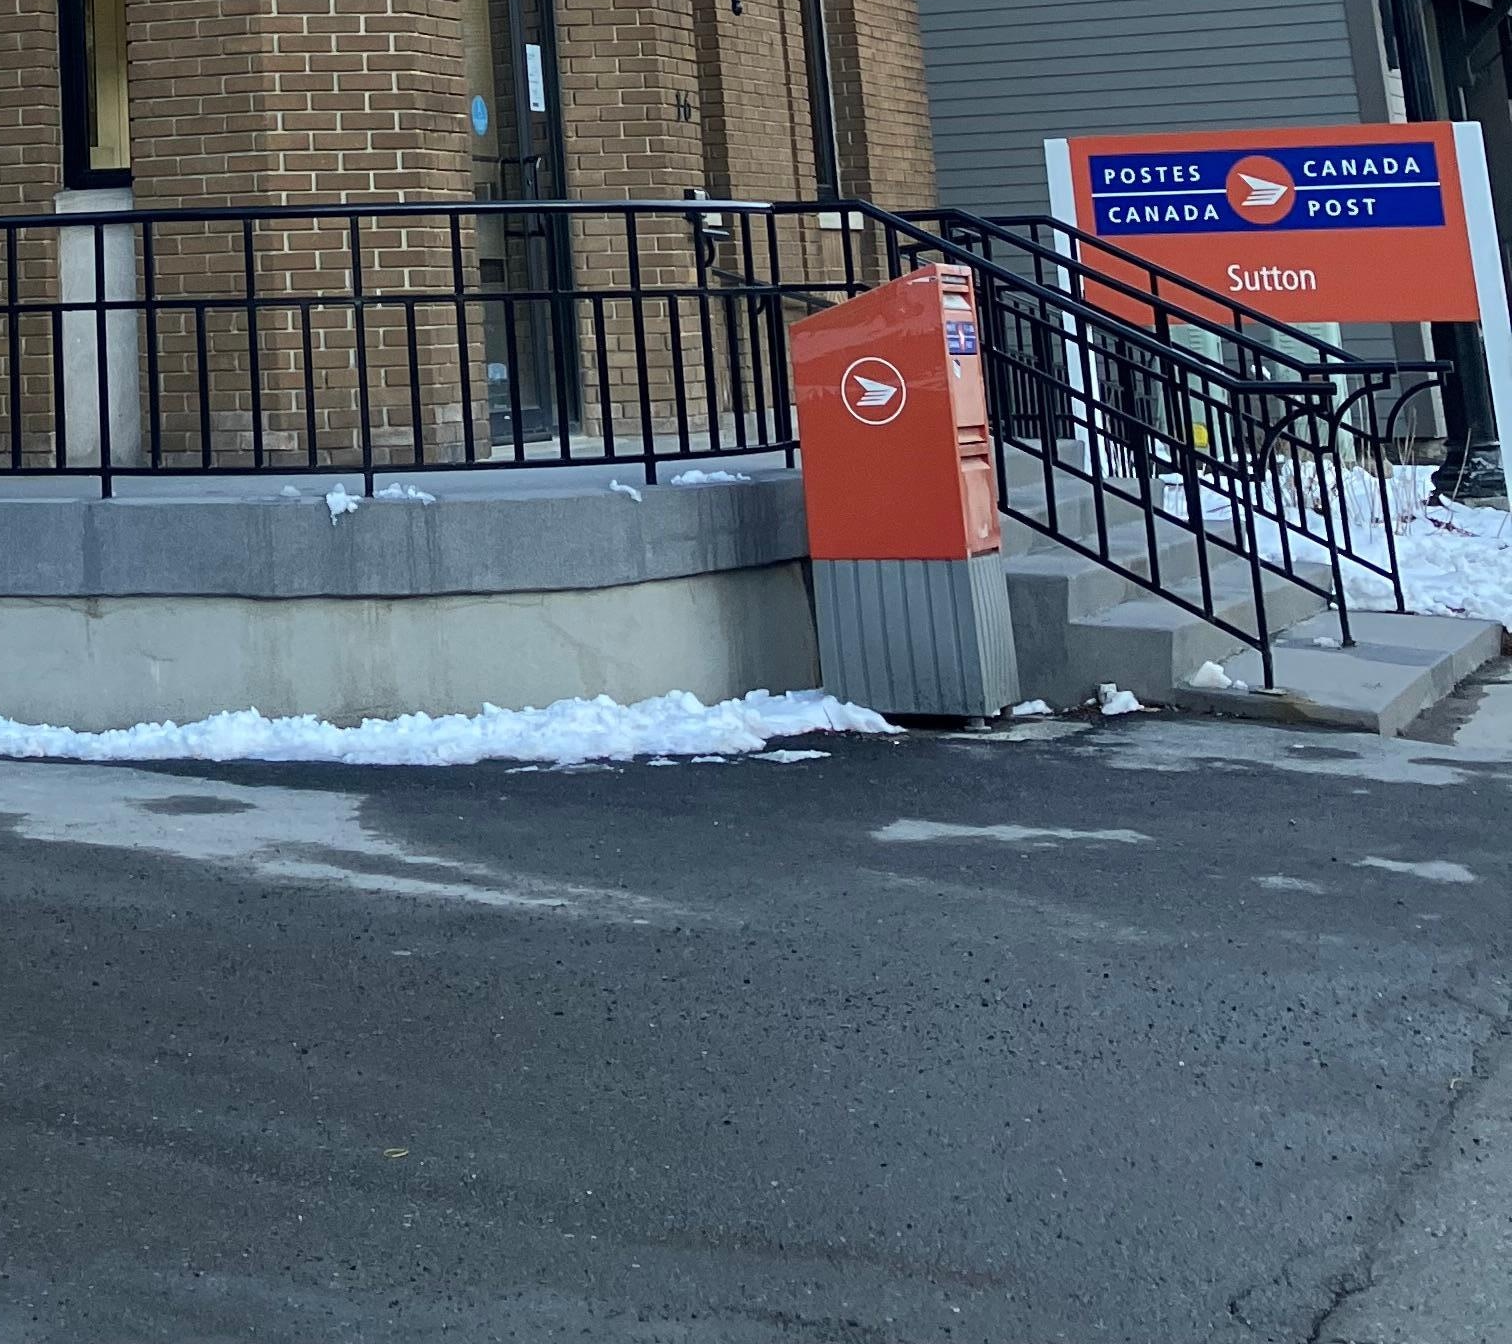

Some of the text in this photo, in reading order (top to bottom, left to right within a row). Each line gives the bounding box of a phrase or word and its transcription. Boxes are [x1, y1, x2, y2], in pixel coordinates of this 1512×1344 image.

[675, 89, 692, 122] 16
[1103, 164, 1202, 185] POSTES
[1302, 156, 1421, 178] CANADA
[1107, 202, 1220, 224] CANADA
[1307, 197, 1377, 218] POST
[1226, 263, 1318, 293] Sutton
